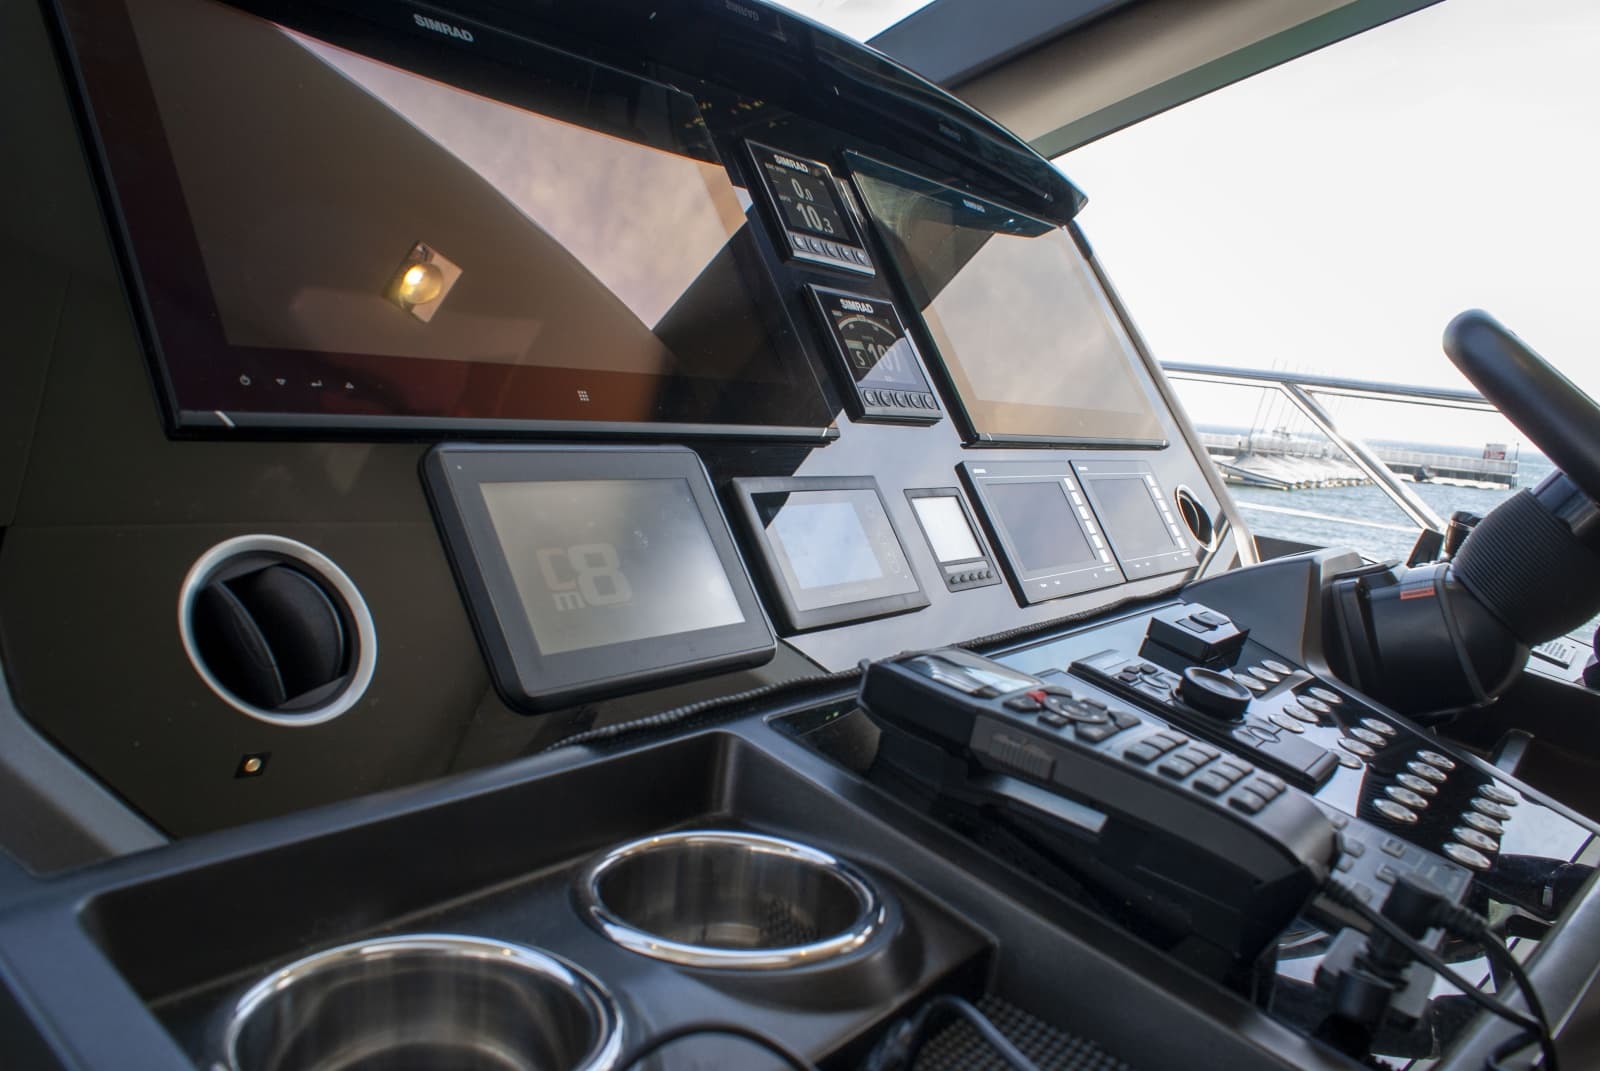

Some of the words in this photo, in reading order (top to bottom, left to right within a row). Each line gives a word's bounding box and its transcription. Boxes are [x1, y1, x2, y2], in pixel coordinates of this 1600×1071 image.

[413, 13, 474, 42] SIMRAD
[773, 153, 809, 173] SIMRAD
[839, 298, 874, 314] SIMRAD
